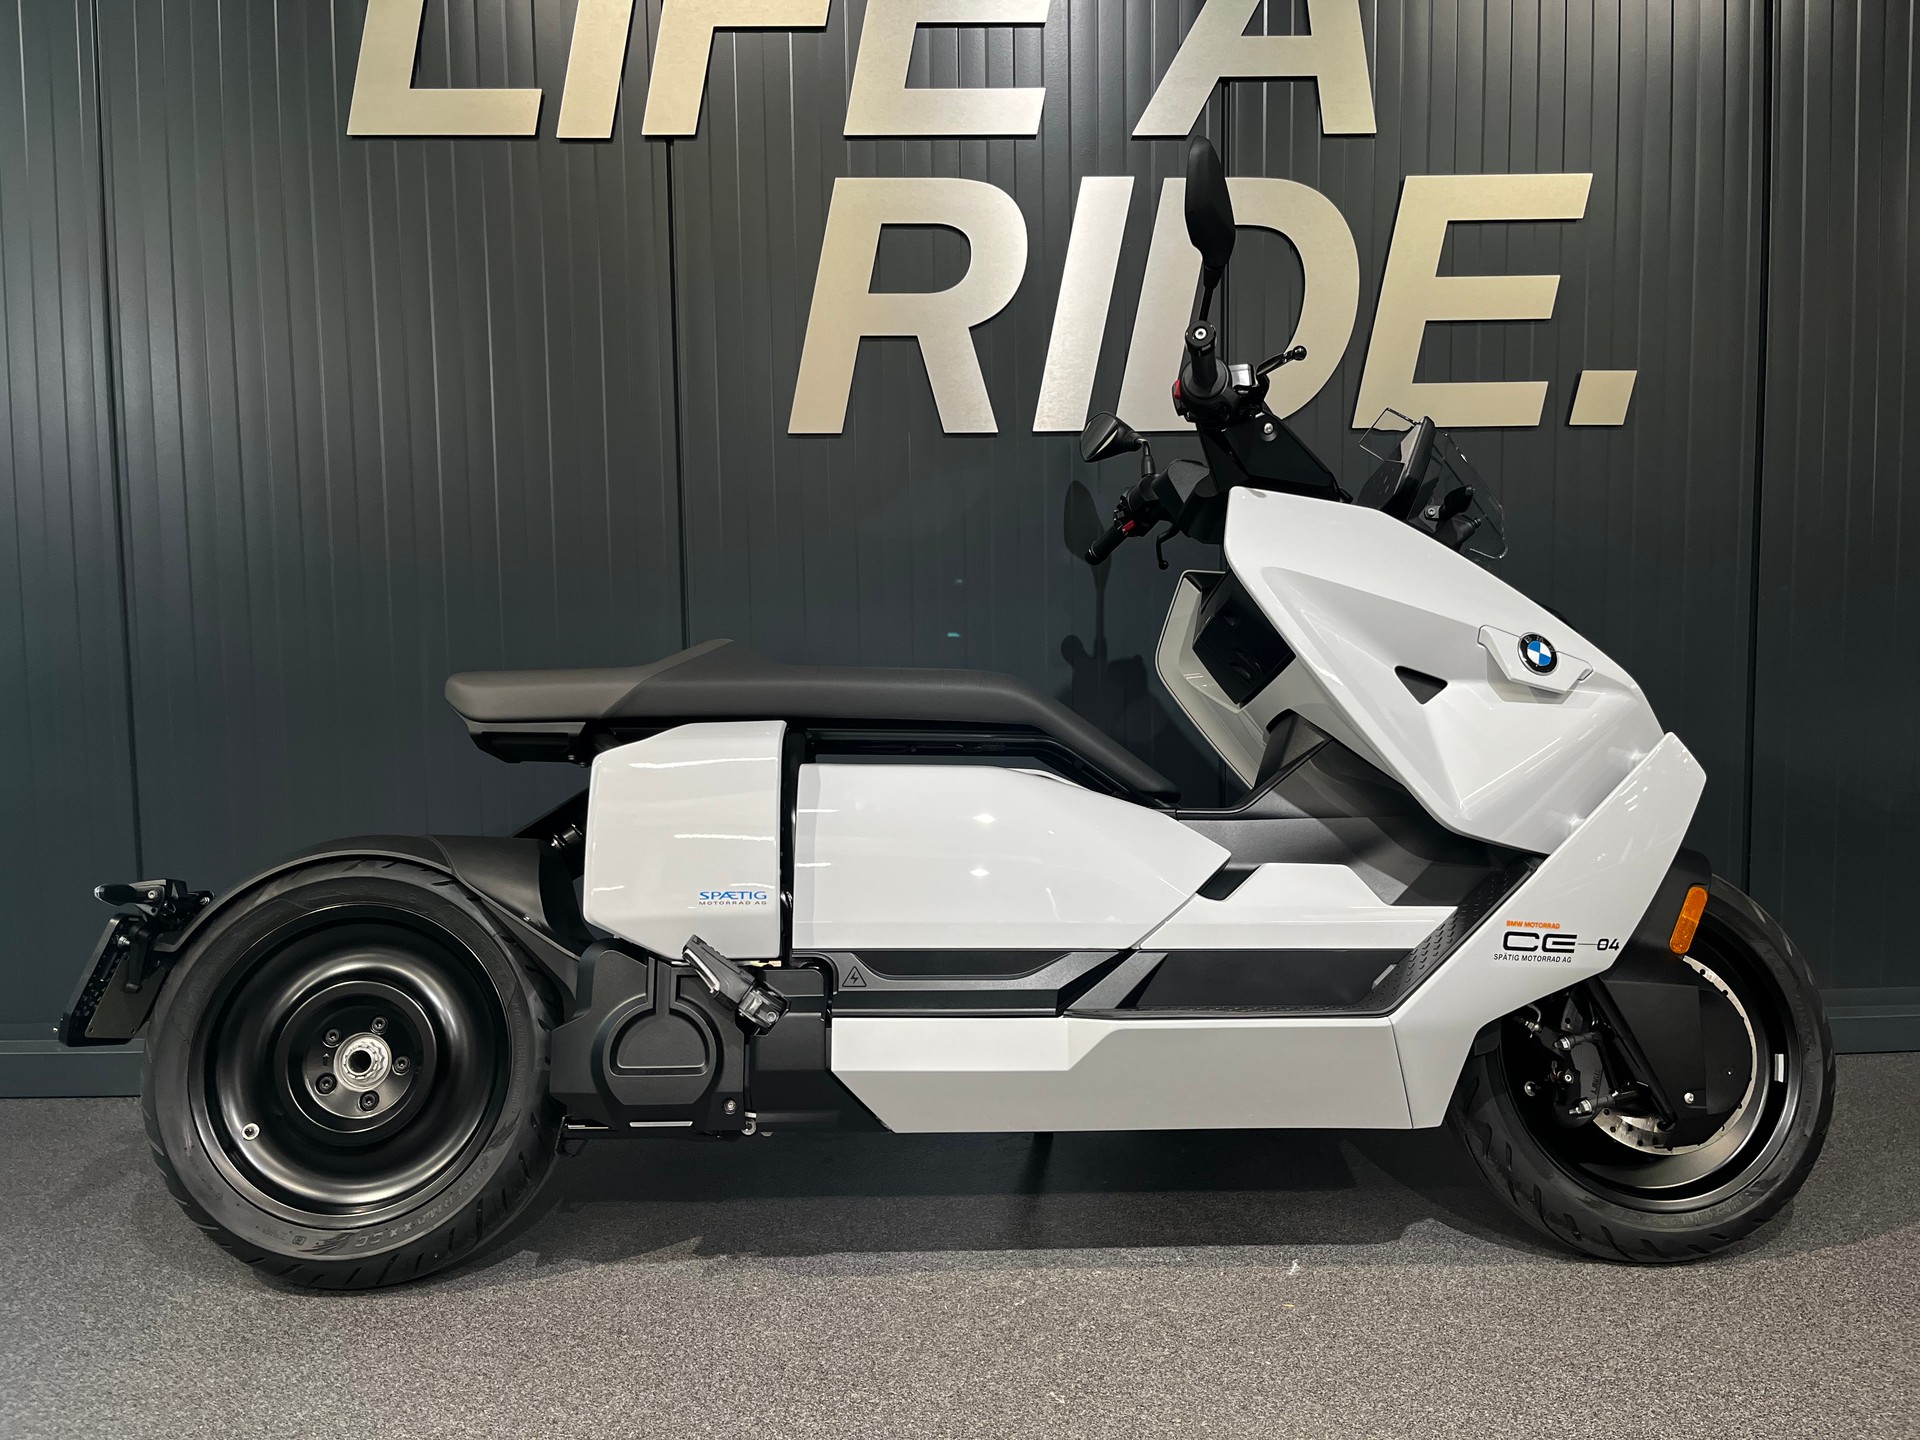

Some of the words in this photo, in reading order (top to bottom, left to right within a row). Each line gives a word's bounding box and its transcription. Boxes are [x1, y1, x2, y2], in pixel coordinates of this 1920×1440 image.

[1131, 0, 1377, 138] A
[788, 173, 1637, 435] RIDE.
[1493, 953, 1520, 961] SPÄTIG
[1521, 955, 1561, 963] MOTORRAD
[1506, 920, 1523, 928] BMW
[1524, 921, 1561, 930] MOTORRAD
